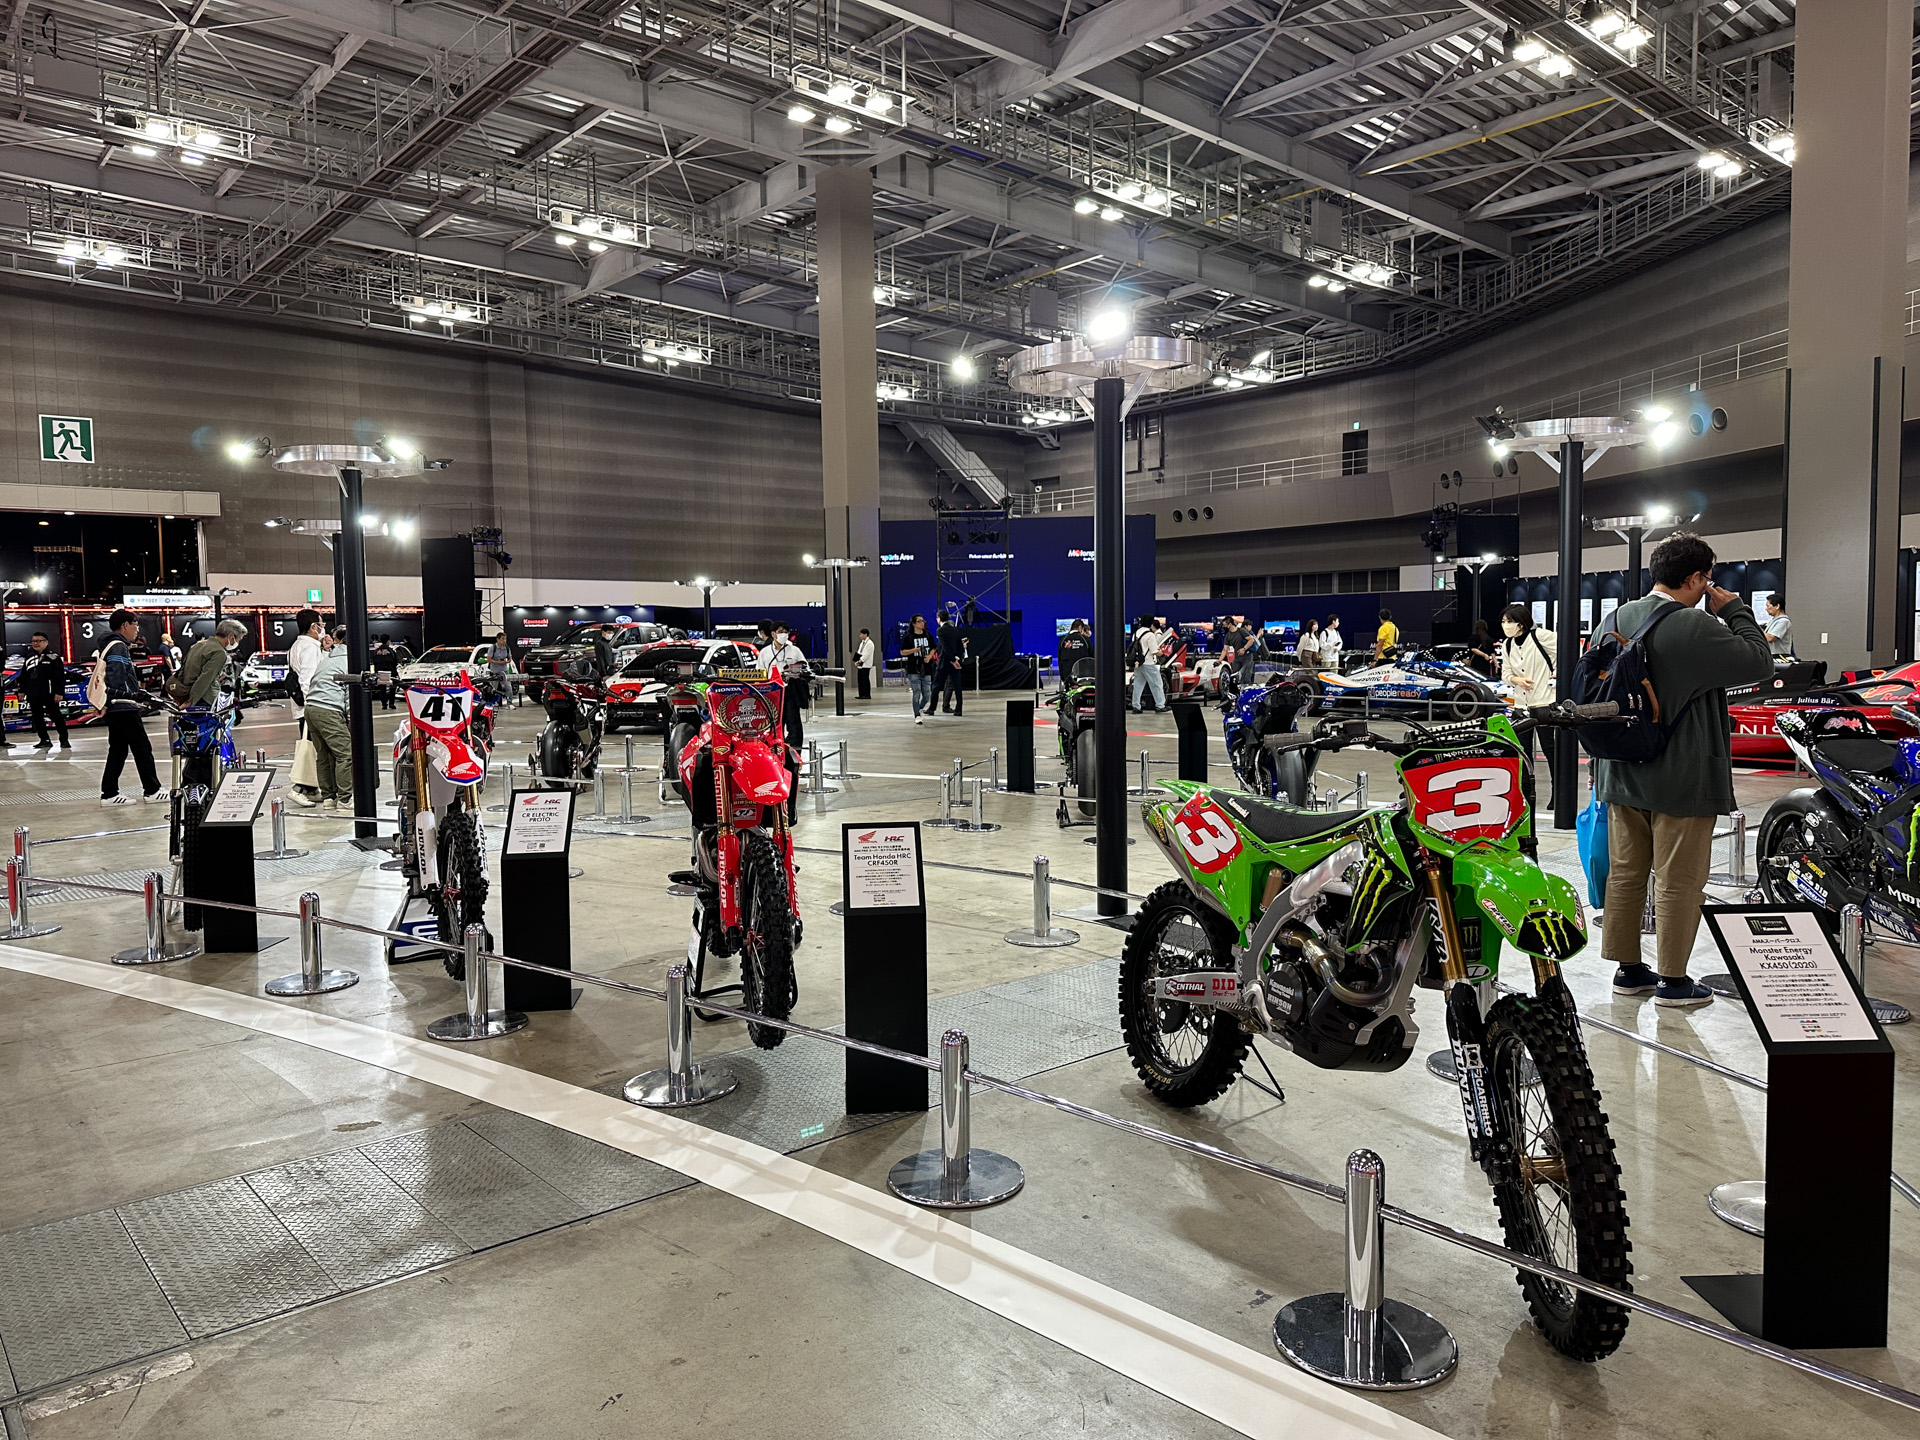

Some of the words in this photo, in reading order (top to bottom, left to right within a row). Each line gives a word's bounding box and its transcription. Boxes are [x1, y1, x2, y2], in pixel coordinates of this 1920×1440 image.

[82, 622, 94, 639] 3
[182, 622, 194, 638] 4
[274, 621, 284, 637] 5
[1375, 689, 1422, 699] peopleready
[4, 700, 15, 709] 61
[420, 696, 463, 722] 41
[731, 715, 766, 723] Champion
[1443, 749, 1486, 759] MONSTER
[1227, 797, 1251, 819] Kawasaki
[1426, 767, 1512, 832] 3
[1175, 810, 1238, 864] 3
[418, 827, 427, 875] DUNLOP
[1251, 840, 1270, 855] 450
[867, 859, 899, 867] CRF450R
[719, 850, 727, 908] DUNLOP
[1799, 883, 1825, 905] MICHELIN
[1869, 909, 1918, 942] YAMAHA
[1764, 953, 1805, 962] Kawasaki
[1783, 947, 1813, 955] Energy
[1269, 978, 1295, 997] Kawasaki
[1281, 991, 1291, 999] Team
[1267, 993, 1292, 1011] HINSON
[1144, 1063, 1173, 1085] DUNLOP
[1452, 1038, 1479, 1139] DUNLOP
[1475, 1078, 1494, 1138] CARRILLO
